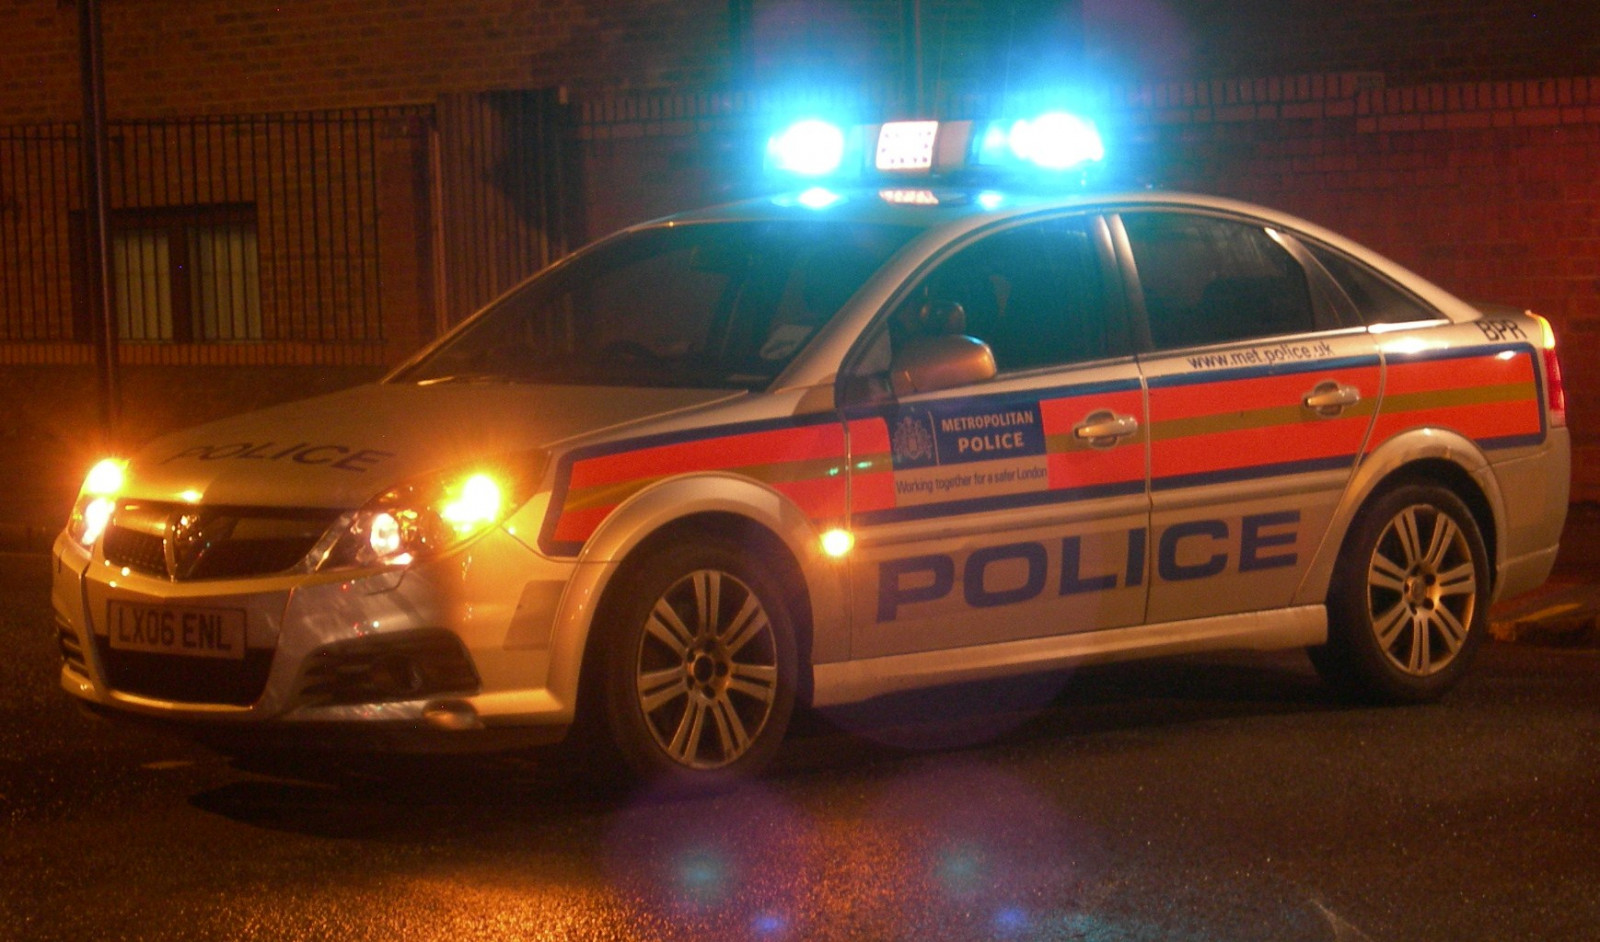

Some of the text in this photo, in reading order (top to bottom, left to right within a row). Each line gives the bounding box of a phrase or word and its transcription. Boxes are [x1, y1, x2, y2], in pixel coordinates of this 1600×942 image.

[1474, 319, 1528, 342] BPR
[1187, 340, 1333, 369] www.met.police.uk
[941, 411, 1034, 432] METROPOLITAN
[958, 431, 1025, 453] POLICE
[158, 442, 398, 473] POLICE
[896, 466, 1048, 495] Working together for a safer London
[876, 510, 1302, 623] POLICE
[118, 606, 232, 651] LX06 ENL
